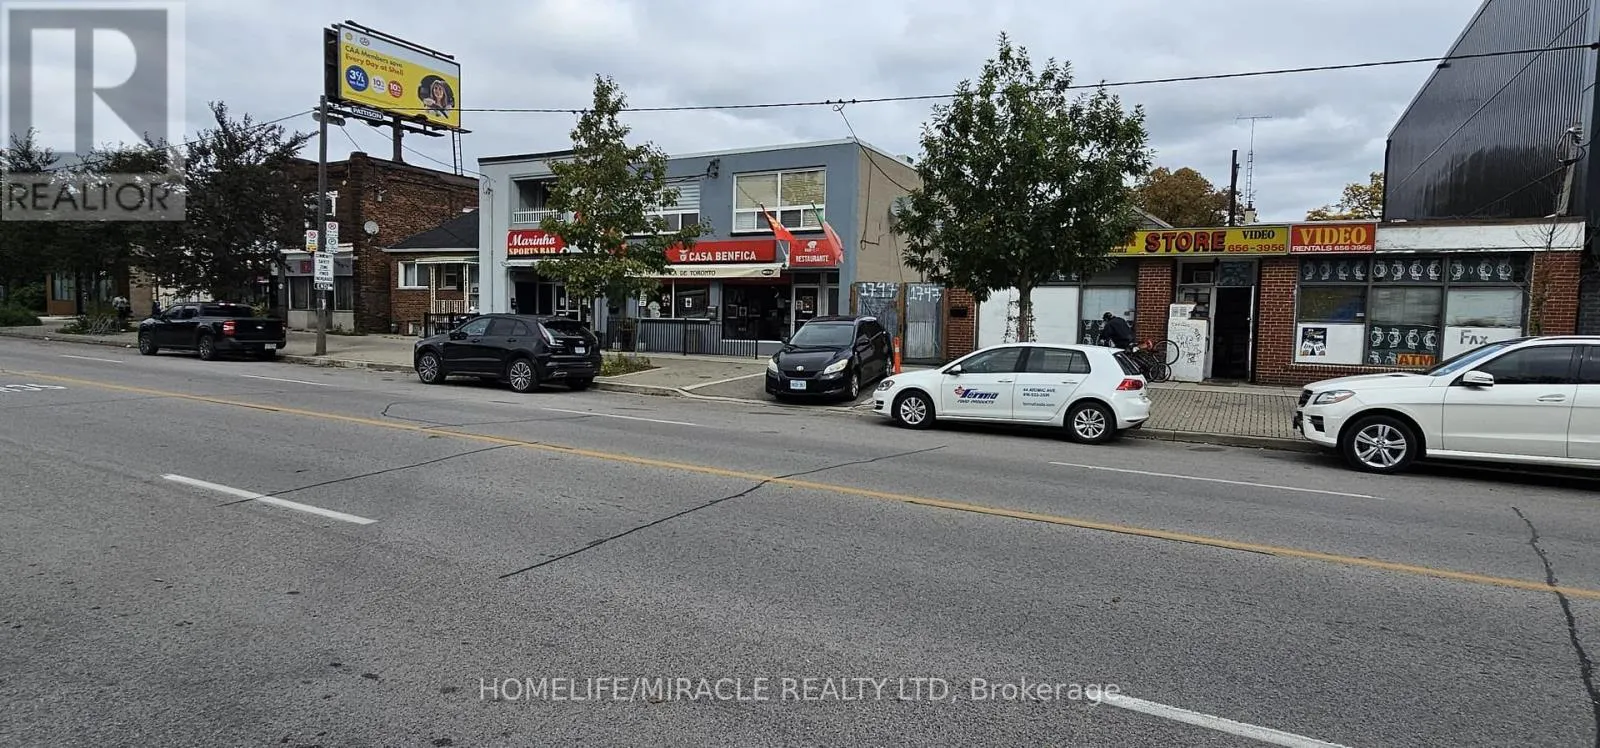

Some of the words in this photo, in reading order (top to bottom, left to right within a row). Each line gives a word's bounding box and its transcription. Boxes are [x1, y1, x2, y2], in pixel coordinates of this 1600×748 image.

[345, 45, 360, 55] CAA
[361, 51, 389, 63] Members
[345, 53, 365, 65] Every
[365, 59, 379, 69] Day
[388, 66, 404, 76] Shell
[353, 107, 382, 119] PATTISON
[509, 233, 556, 246] Marinho
[1145, 231, 1227, 252] STORE
[1242, 230, 1275, 240] VIDEO
[1300, 226, 1367, 245] VIDEO
[509, 247, 539, 255] SPORTS
[1228, 243, 1285, 252] 656-3956
[689, 252, 713, 261] CASA
[715, 251, 757, 261] BENFICA
[861, 282, 897, 298] 1747
[909, 286, 941, 302] 1747
[1399, 354, 1434, 366] ATM
